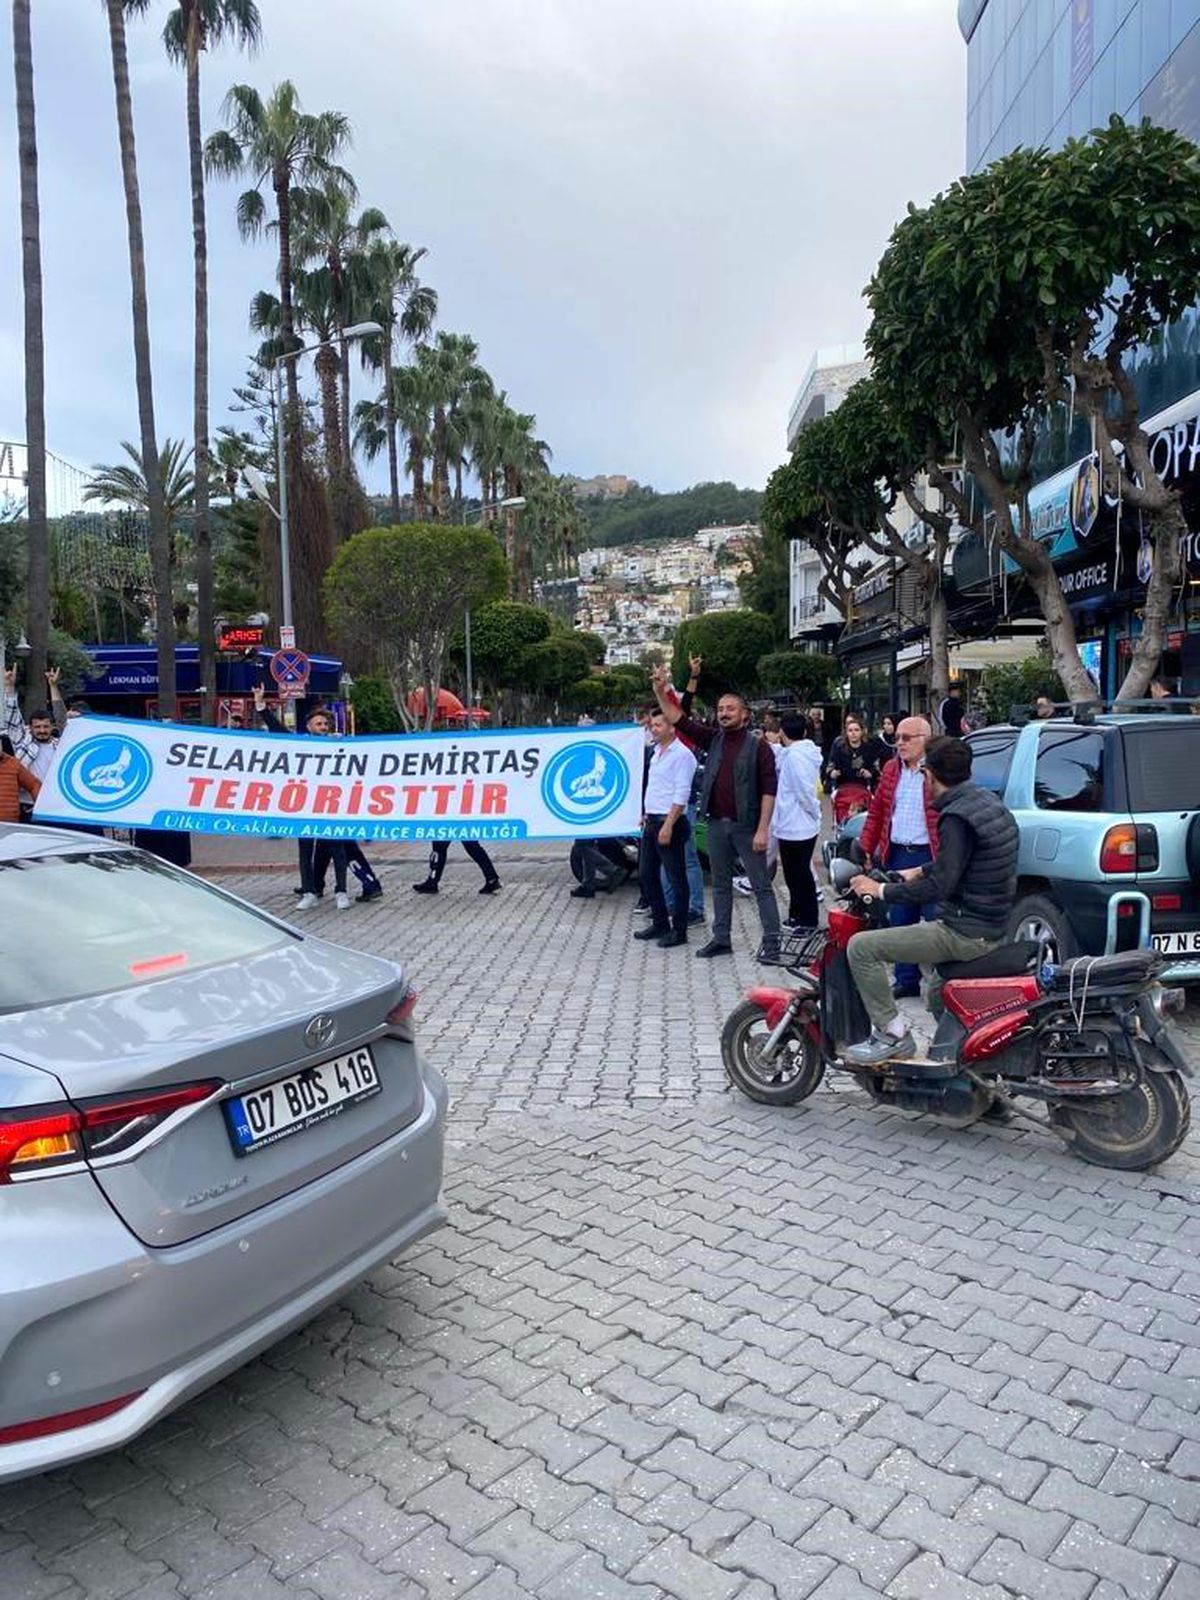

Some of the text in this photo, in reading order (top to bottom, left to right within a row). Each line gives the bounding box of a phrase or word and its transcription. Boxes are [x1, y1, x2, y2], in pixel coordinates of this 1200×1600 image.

[1075, 562, 1108, 590] OFFICE
[166, 743, 540, 778] SELAHATTİN DEMİRTAŞ
[187, 777, 508, 816] TERÖRİSTTİR
[163, 812, 207, 829] Ülkü
[300, 822, 366, 837] ALANYA
[371, 825, 410, 840] İLÇE
[415, 824, 519, 839] BAŞKANLIĞI
[1152, 935, 1171, 952] 07
[1177, 934, 1188, 951] N
[246, 1089, 275, 1134] 07
[283, 1070, 329, 1118] BDS
[333, 1052, 373, 1094] 416
[237, 1124, 250, 1137] TR
